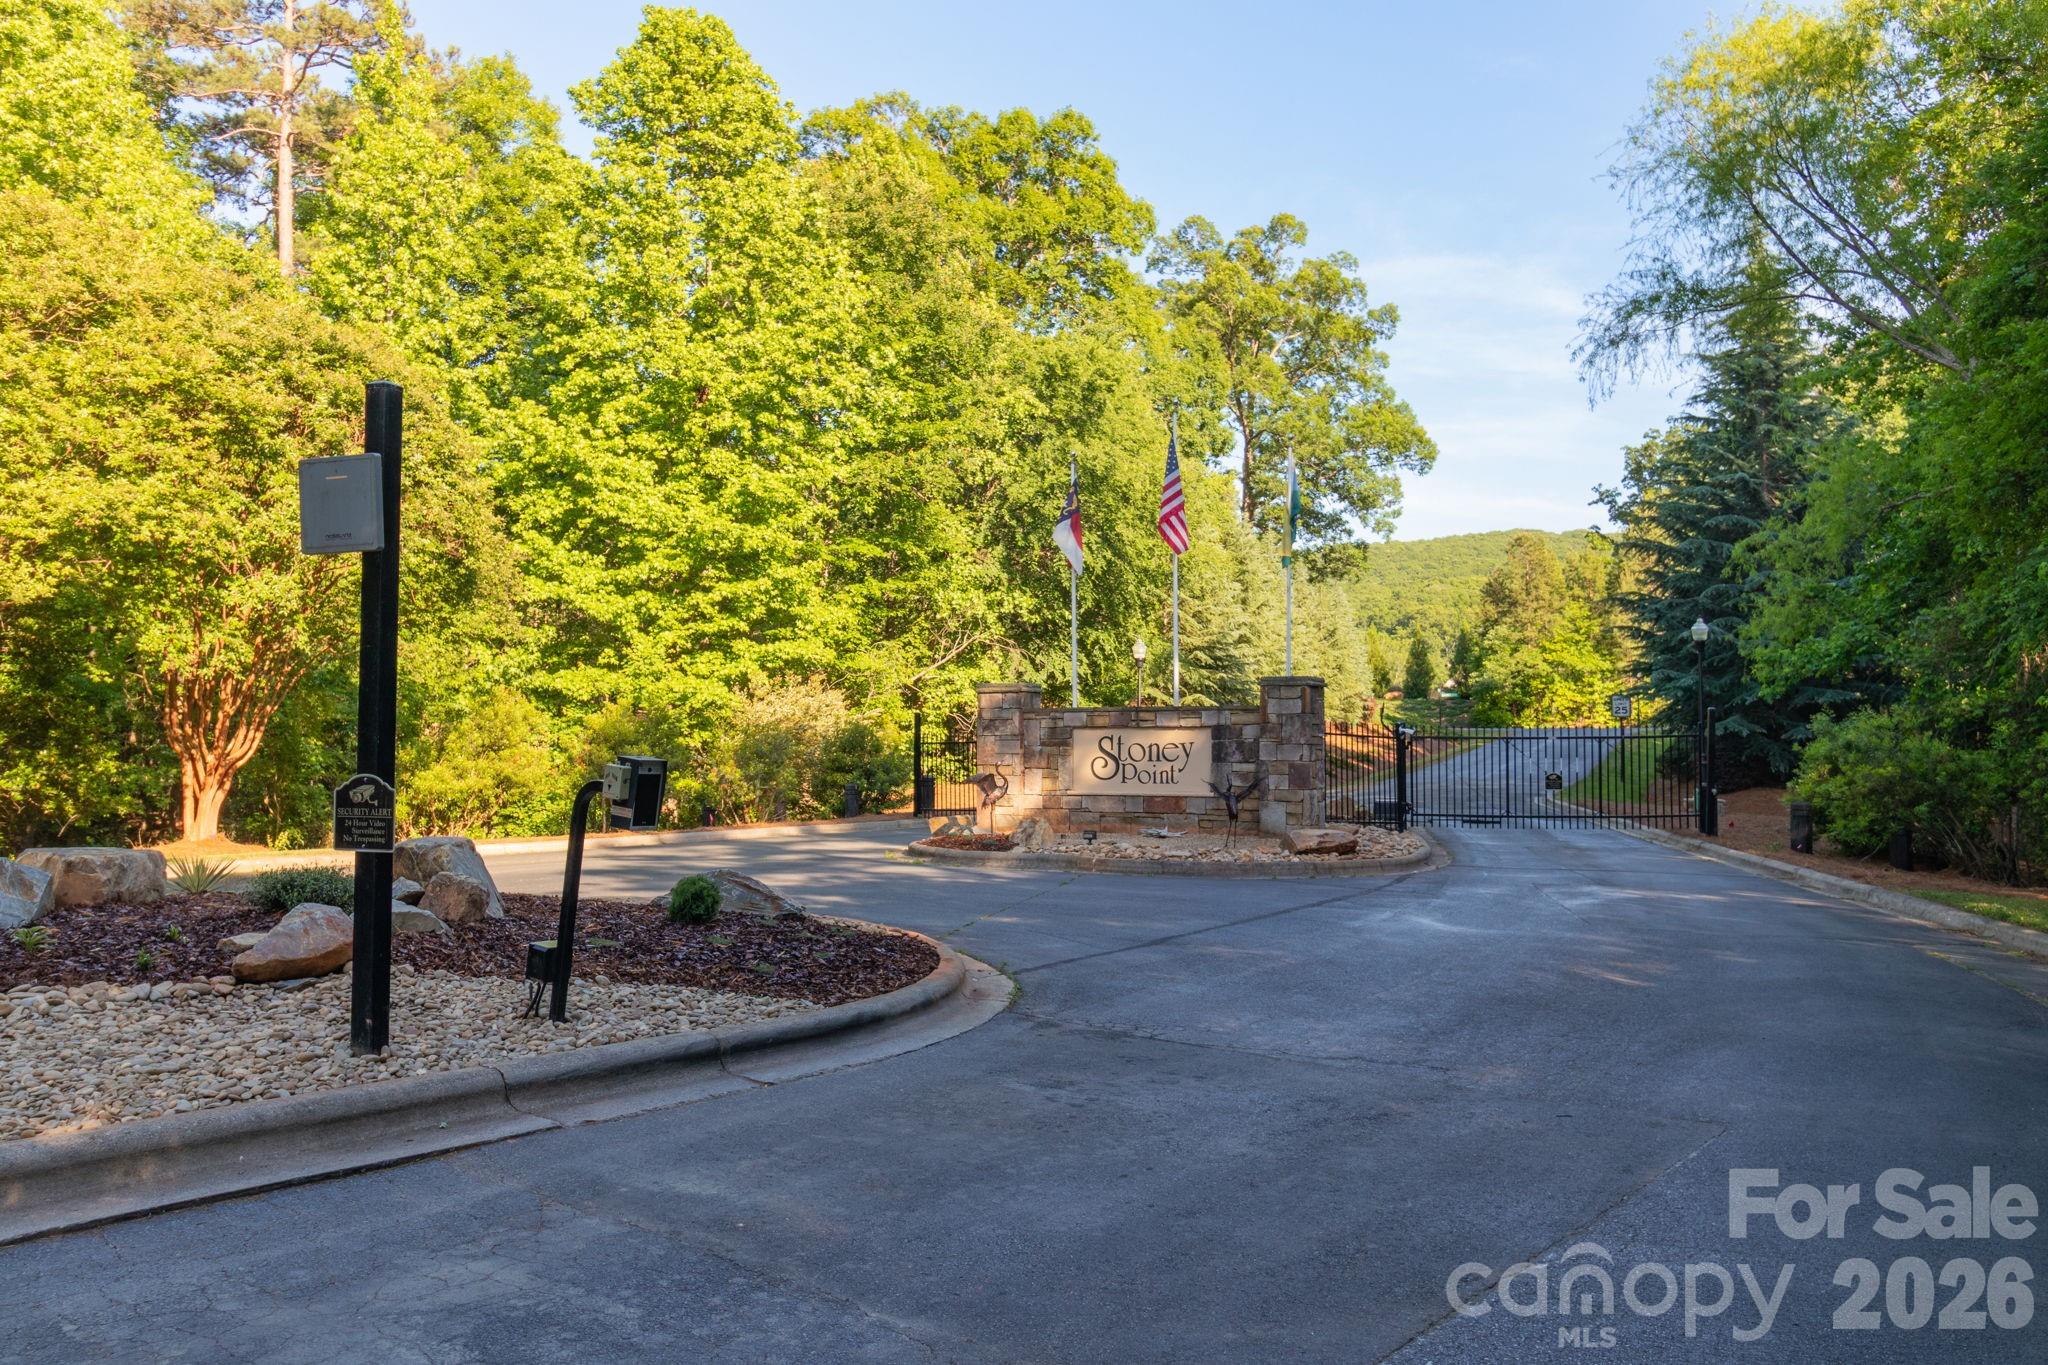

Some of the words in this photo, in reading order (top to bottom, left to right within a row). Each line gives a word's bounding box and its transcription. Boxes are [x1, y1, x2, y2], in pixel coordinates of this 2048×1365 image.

[1614, 706, 1628, 714] 25
[1091, 735, 1194, 780] Stoney
[1120, 763, 1179, 785] Point
[337, 807, 369, 816] SECURITY
[370, 808, 392, 816] ALERT
[351, 827, 386, 835] Surveillance
[343, 834, 353, 842] No
